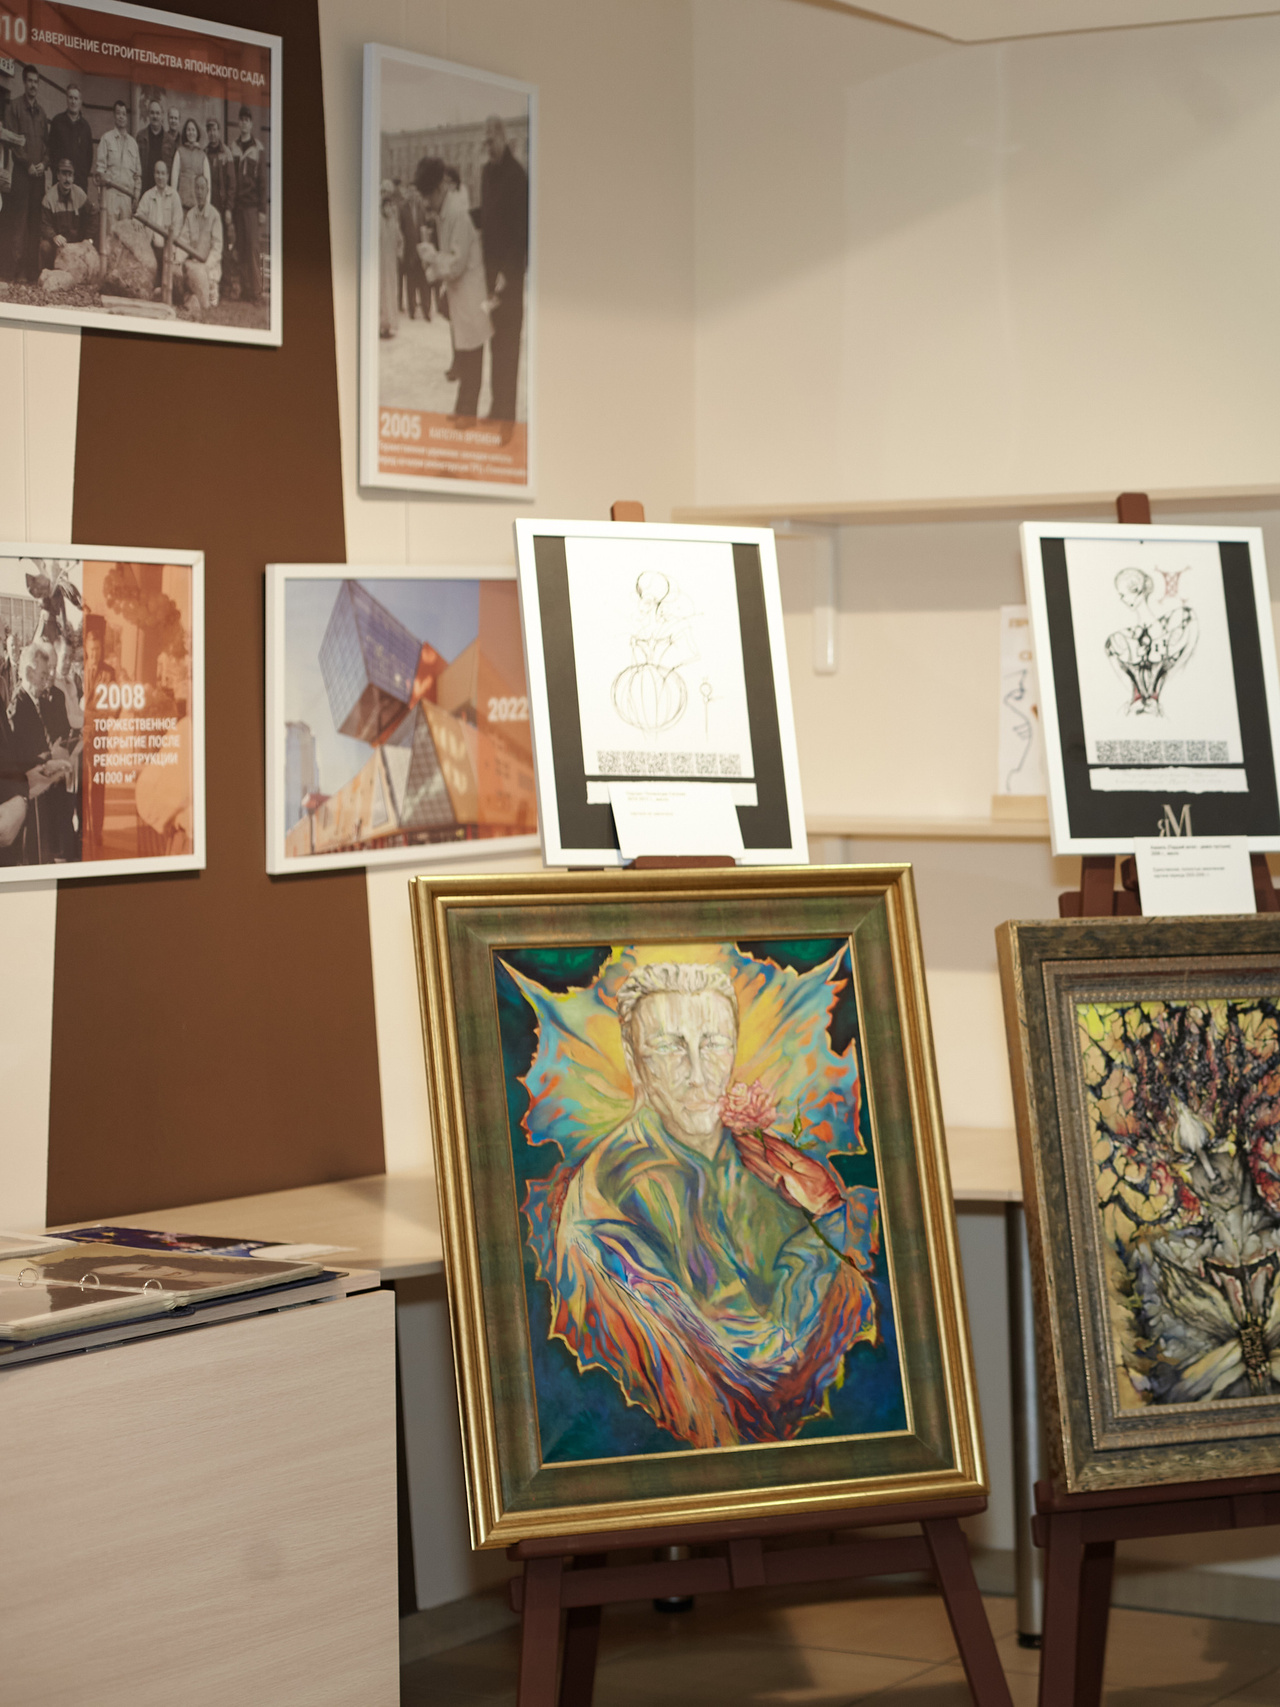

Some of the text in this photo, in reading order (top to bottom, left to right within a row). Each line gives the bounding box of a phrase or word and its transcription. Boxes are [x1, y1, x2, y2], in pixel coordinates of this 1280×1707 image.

[0, 15, 265, 87] 10 ЗАВЕРШЕНИЕ СТРОИТЕЛЬСТВА ЯПОНСКОГО САДА
[380, 412, 422, 440] 2005
[95, 684, 144, 709] 2008
[488, 696, 528, 722] 2022
[93, 718, 177, 731] ТОРЖЕСТВЕННОЕ
[93, 735, 180, 749] ОТКРЫТИЕ ПОСЛЕ
[93, 753, 177, 767] РЕКОНСТРУКЦИИ
[93, 771, 123, 785] 41000
